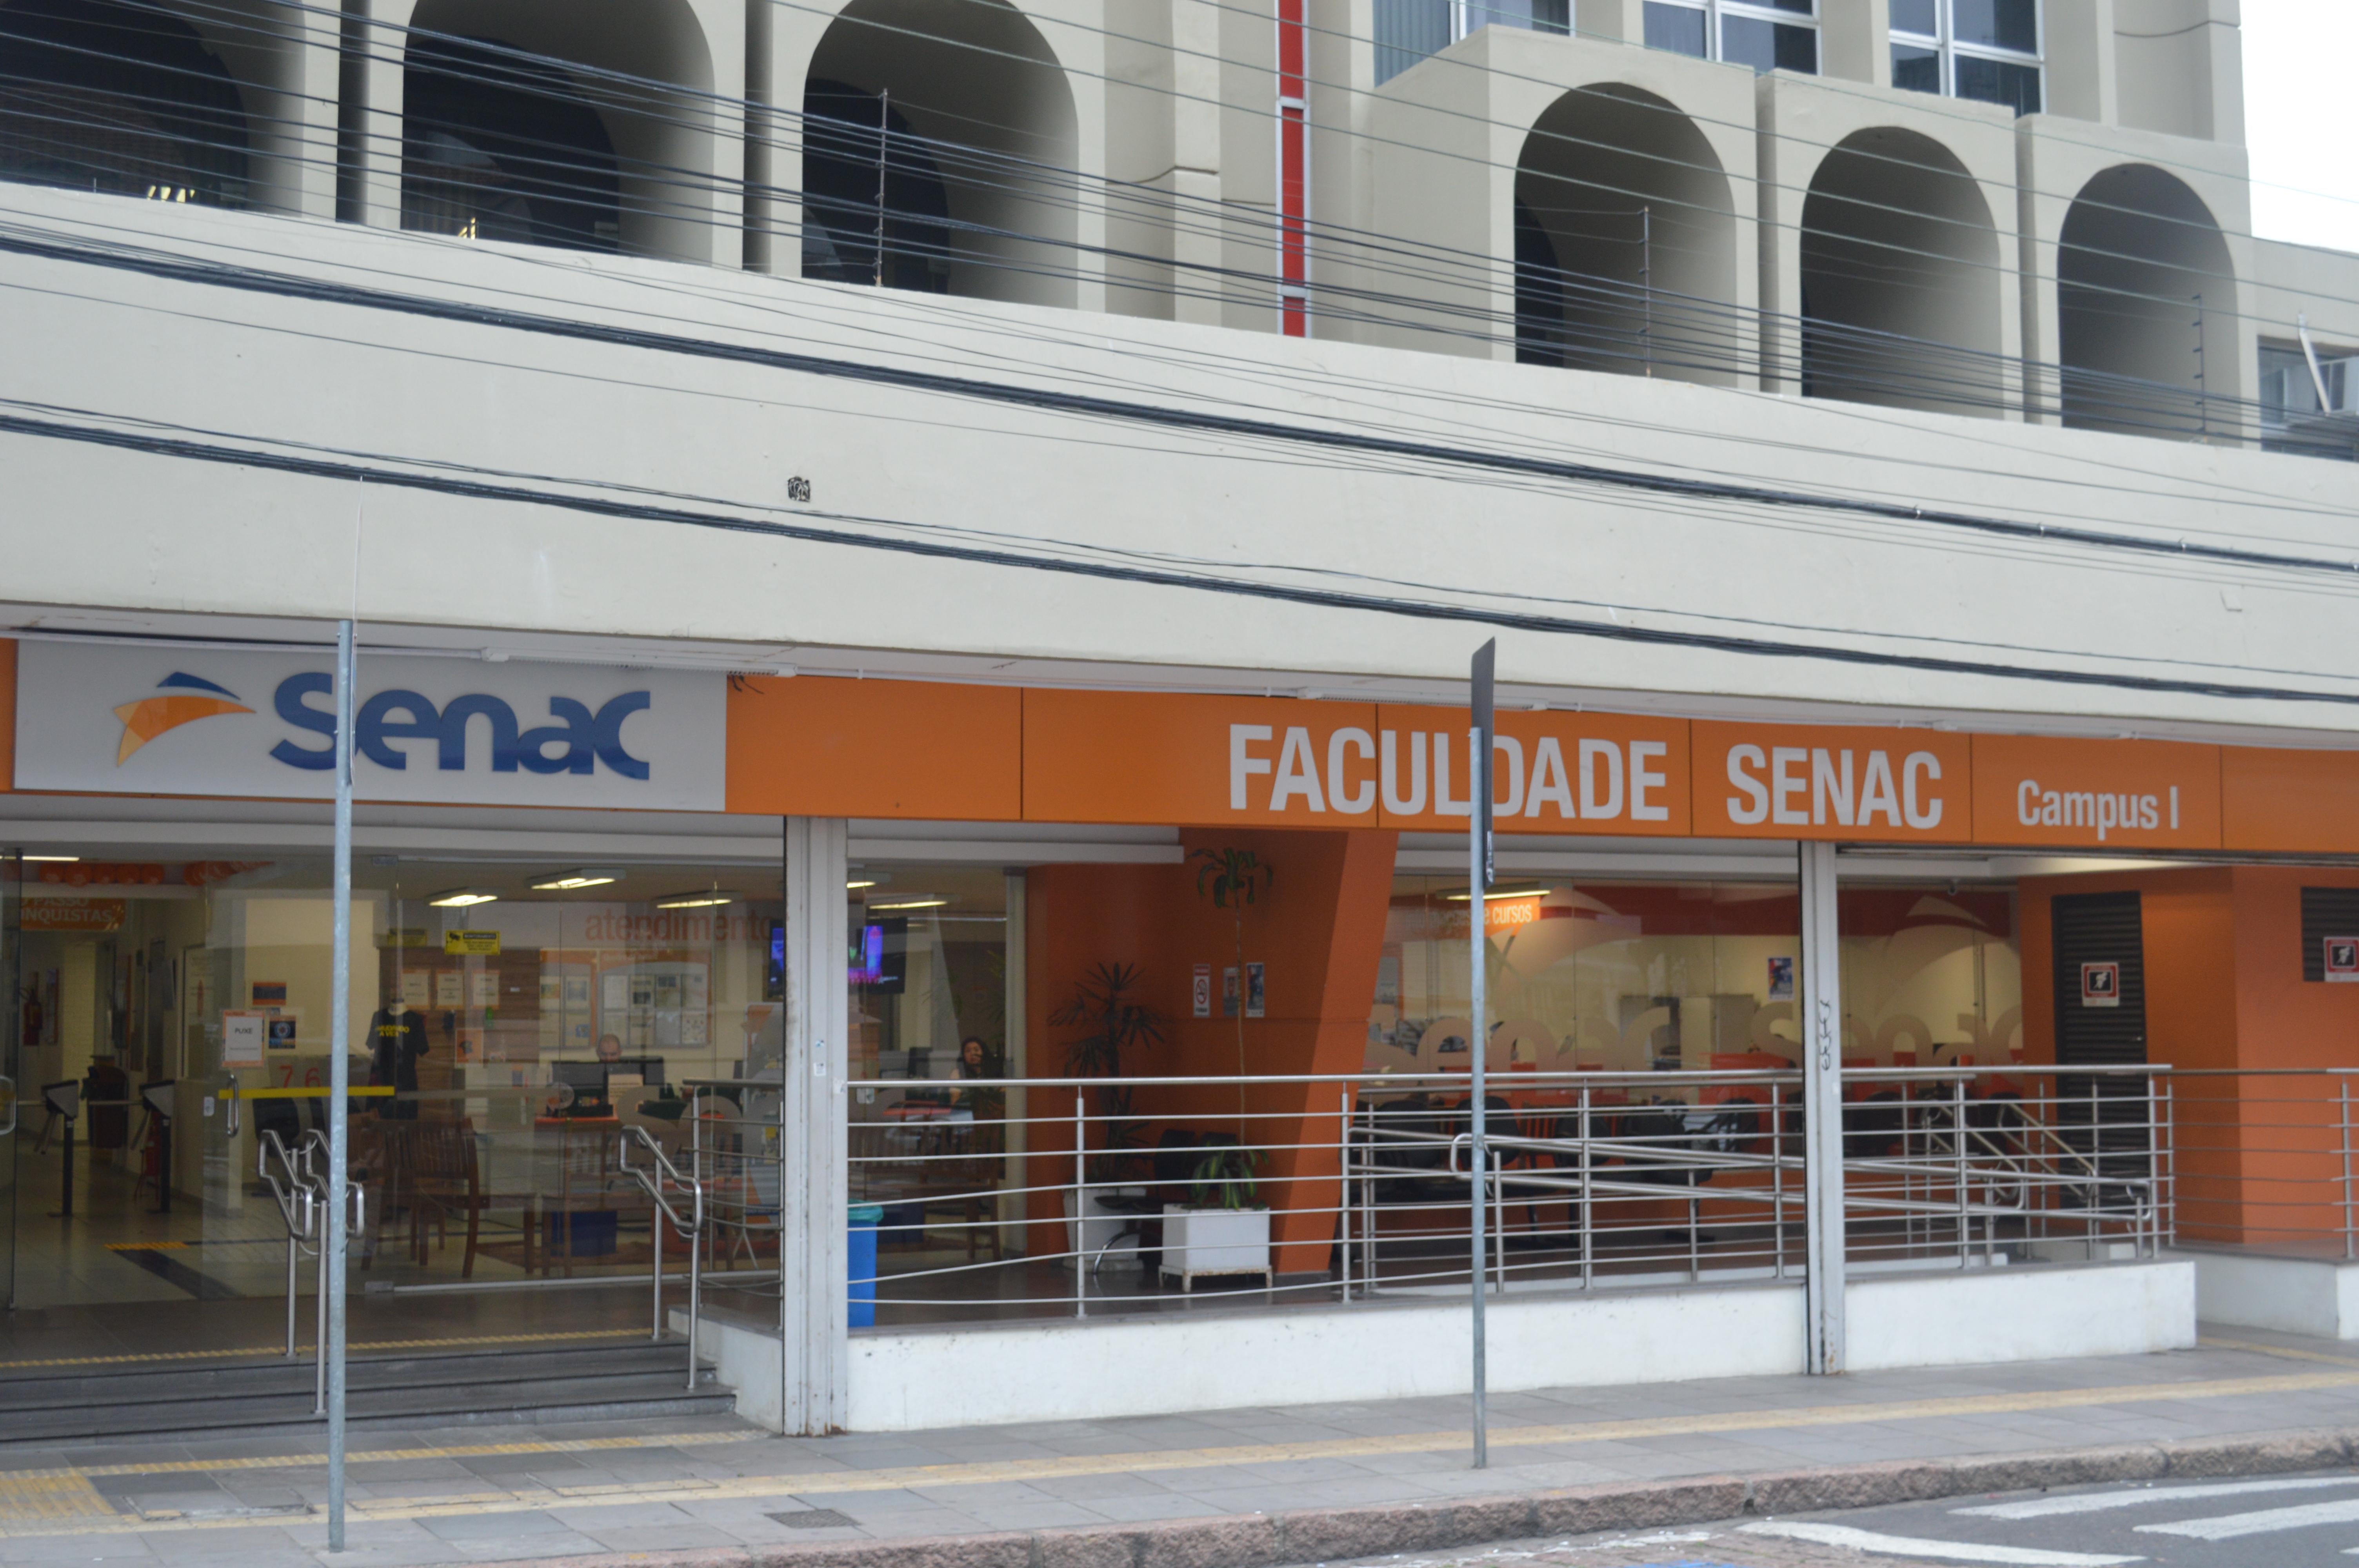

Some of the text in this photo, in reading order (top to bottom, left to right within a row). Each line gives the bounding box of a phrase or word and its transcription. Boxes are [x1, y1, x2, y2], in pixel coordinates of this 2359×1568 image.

[1229, 724, 2179, 841] FACULDADE SENAC Campus I
[21, 907, 112, 924] NQUISTAS
[1492, 904, 1532, 924] cursos
